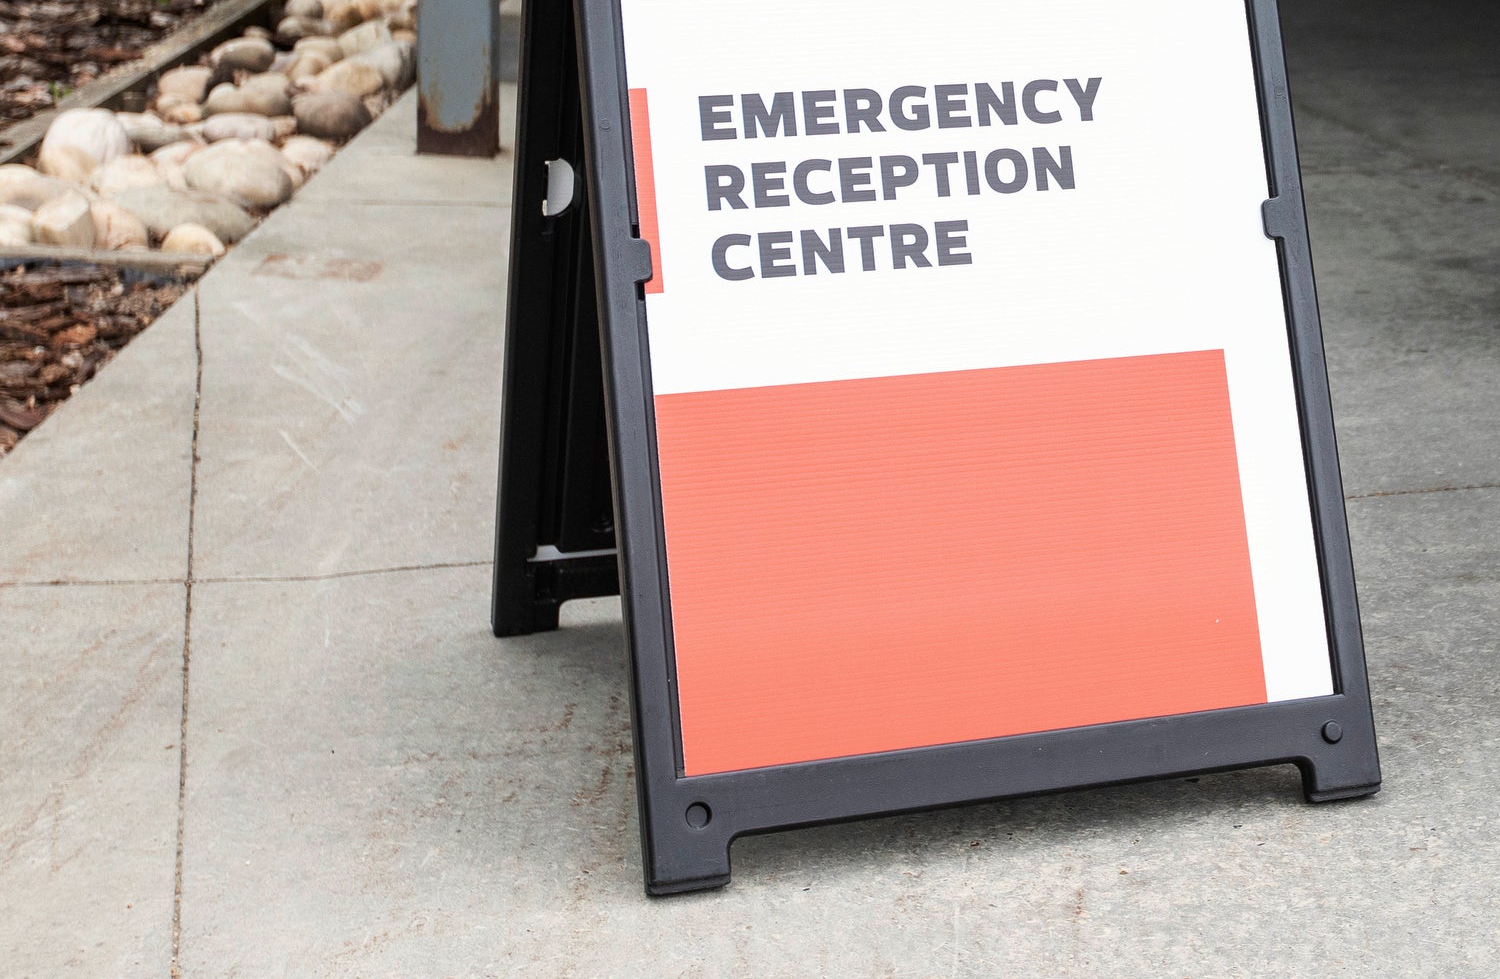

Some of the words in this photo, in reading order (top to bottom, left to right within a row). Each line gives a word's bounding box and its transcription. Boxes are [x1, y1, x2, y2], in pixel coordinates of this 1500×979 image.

[698, 77, 1102, 141] EMERGENCY
[704, 145, 1075, 211] RECEPTION
[711, 219, 972, 281] CENTRE
